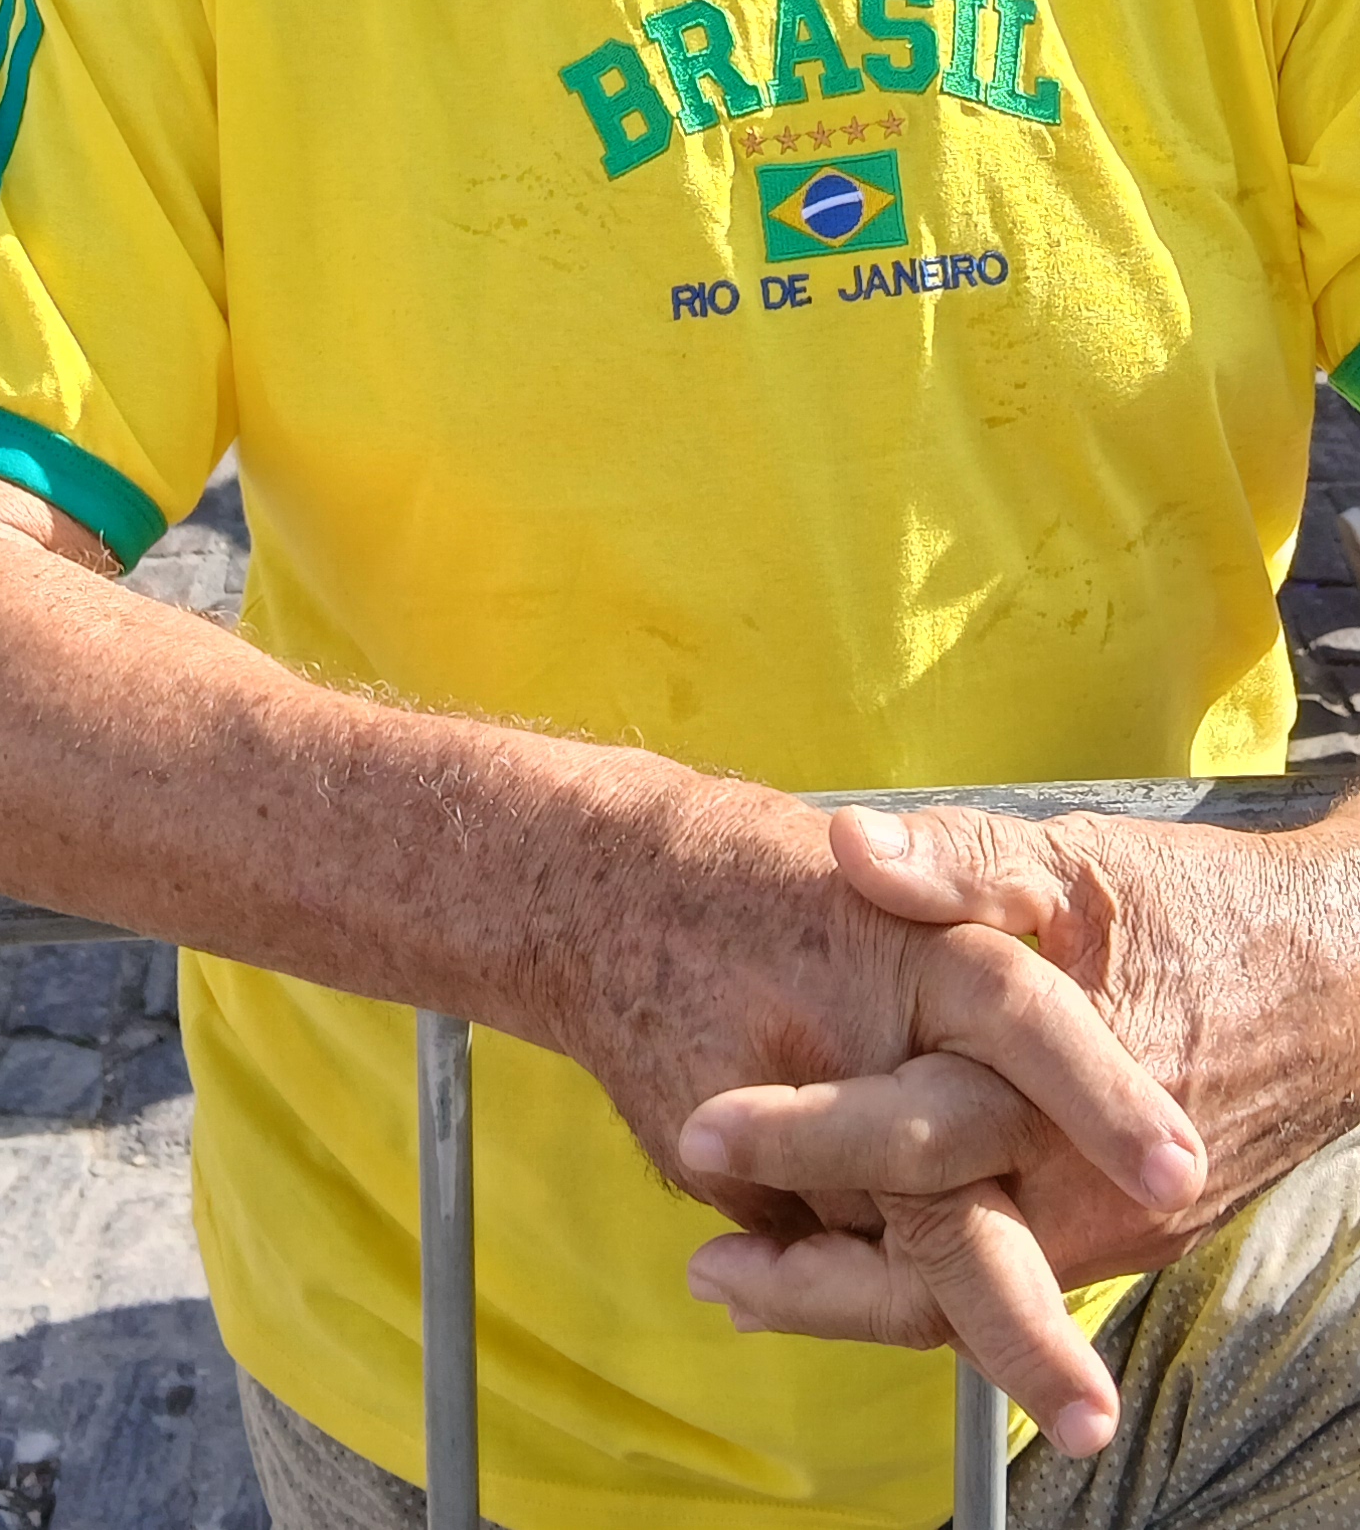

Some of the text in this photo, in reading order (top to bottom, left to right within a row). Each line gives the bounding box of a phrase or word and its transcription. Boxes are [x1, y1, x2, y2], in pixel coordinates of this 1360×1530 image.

[670, 250, 1010, 321] RIO DE JANEIRO
